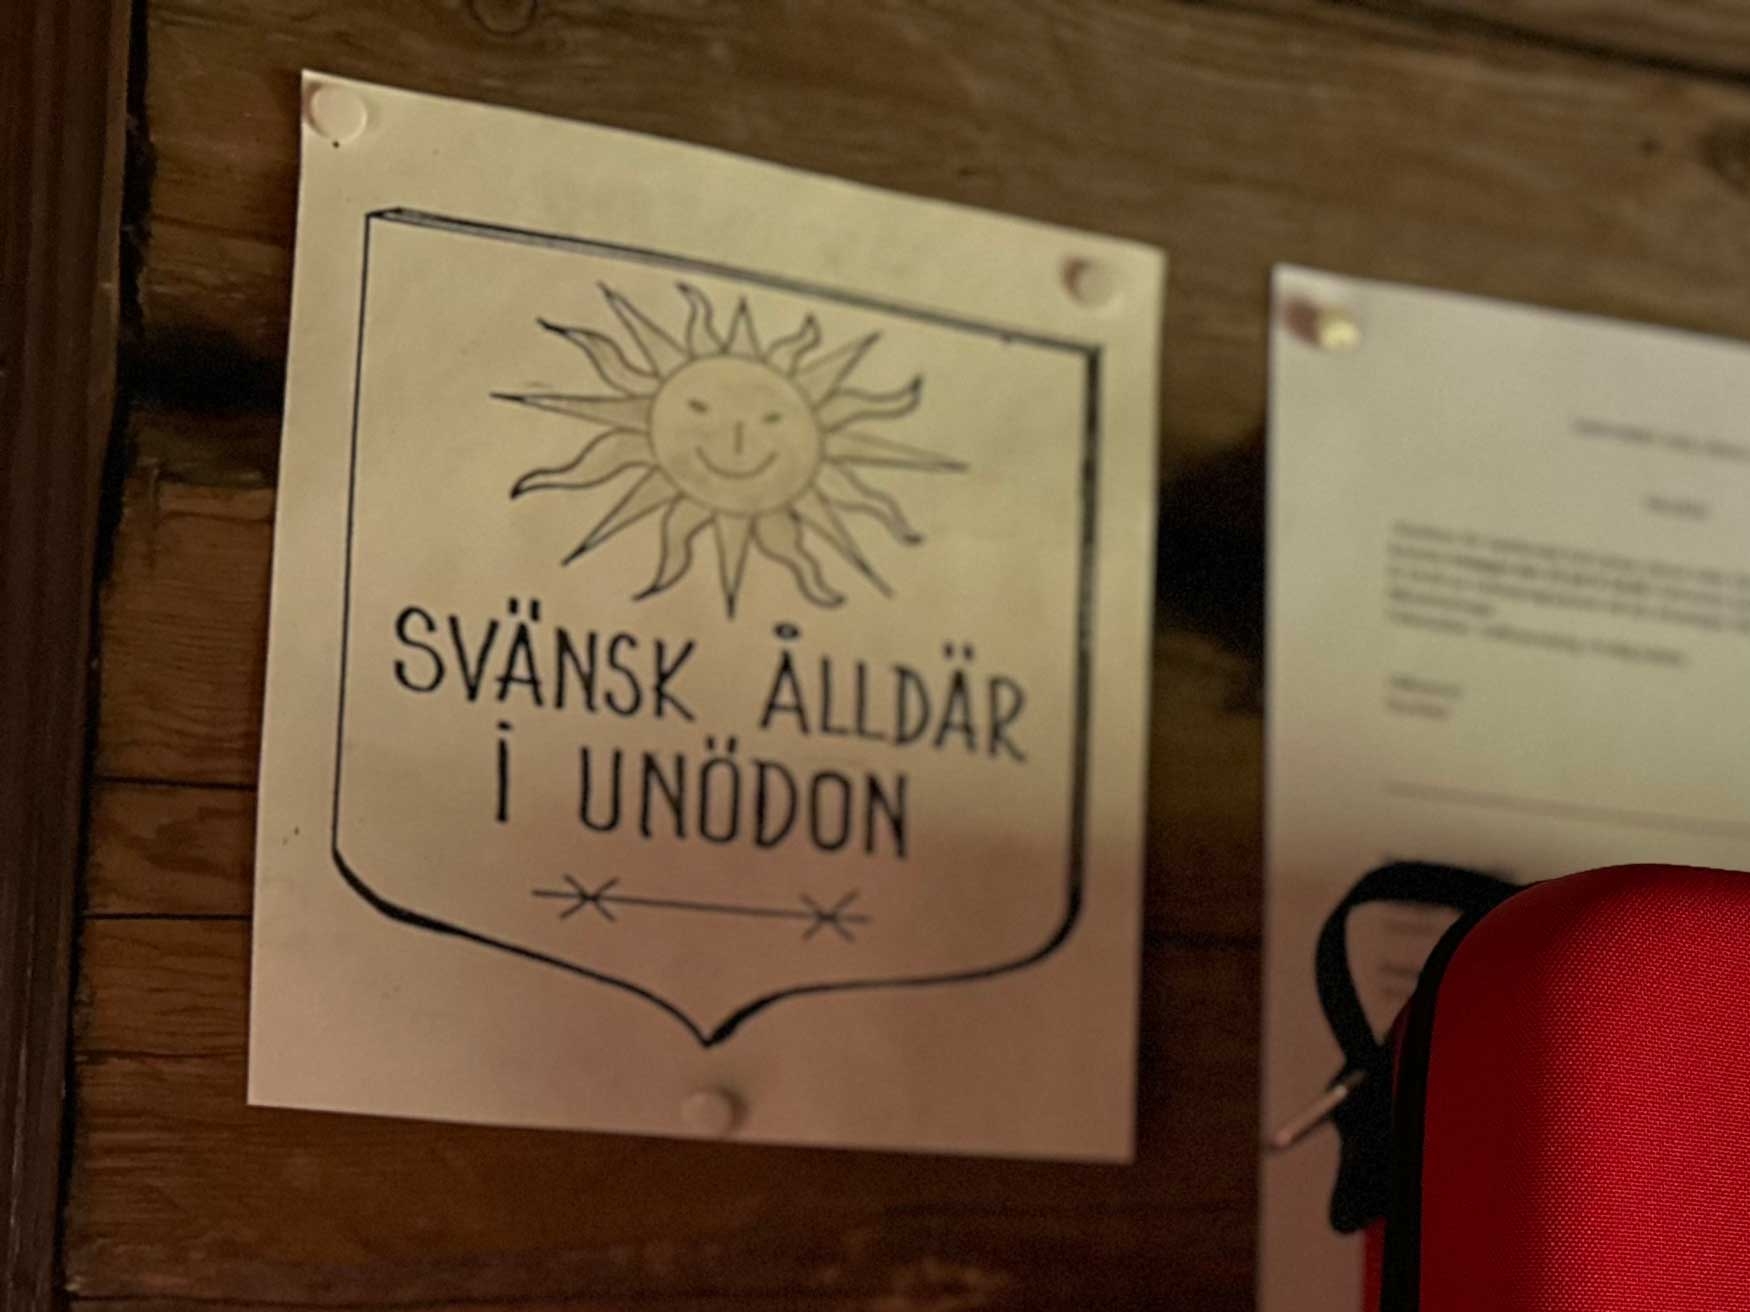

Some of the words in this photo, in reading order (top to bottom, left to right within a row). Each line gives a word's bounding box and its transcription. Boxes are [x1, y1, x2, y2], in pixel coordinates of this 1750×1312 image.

[394, 596, 697, 723] SVÄNSK
[759, 622, 1030, 765] ÅLLDÄR
[578, 736, 911, 861] UNÖDON
